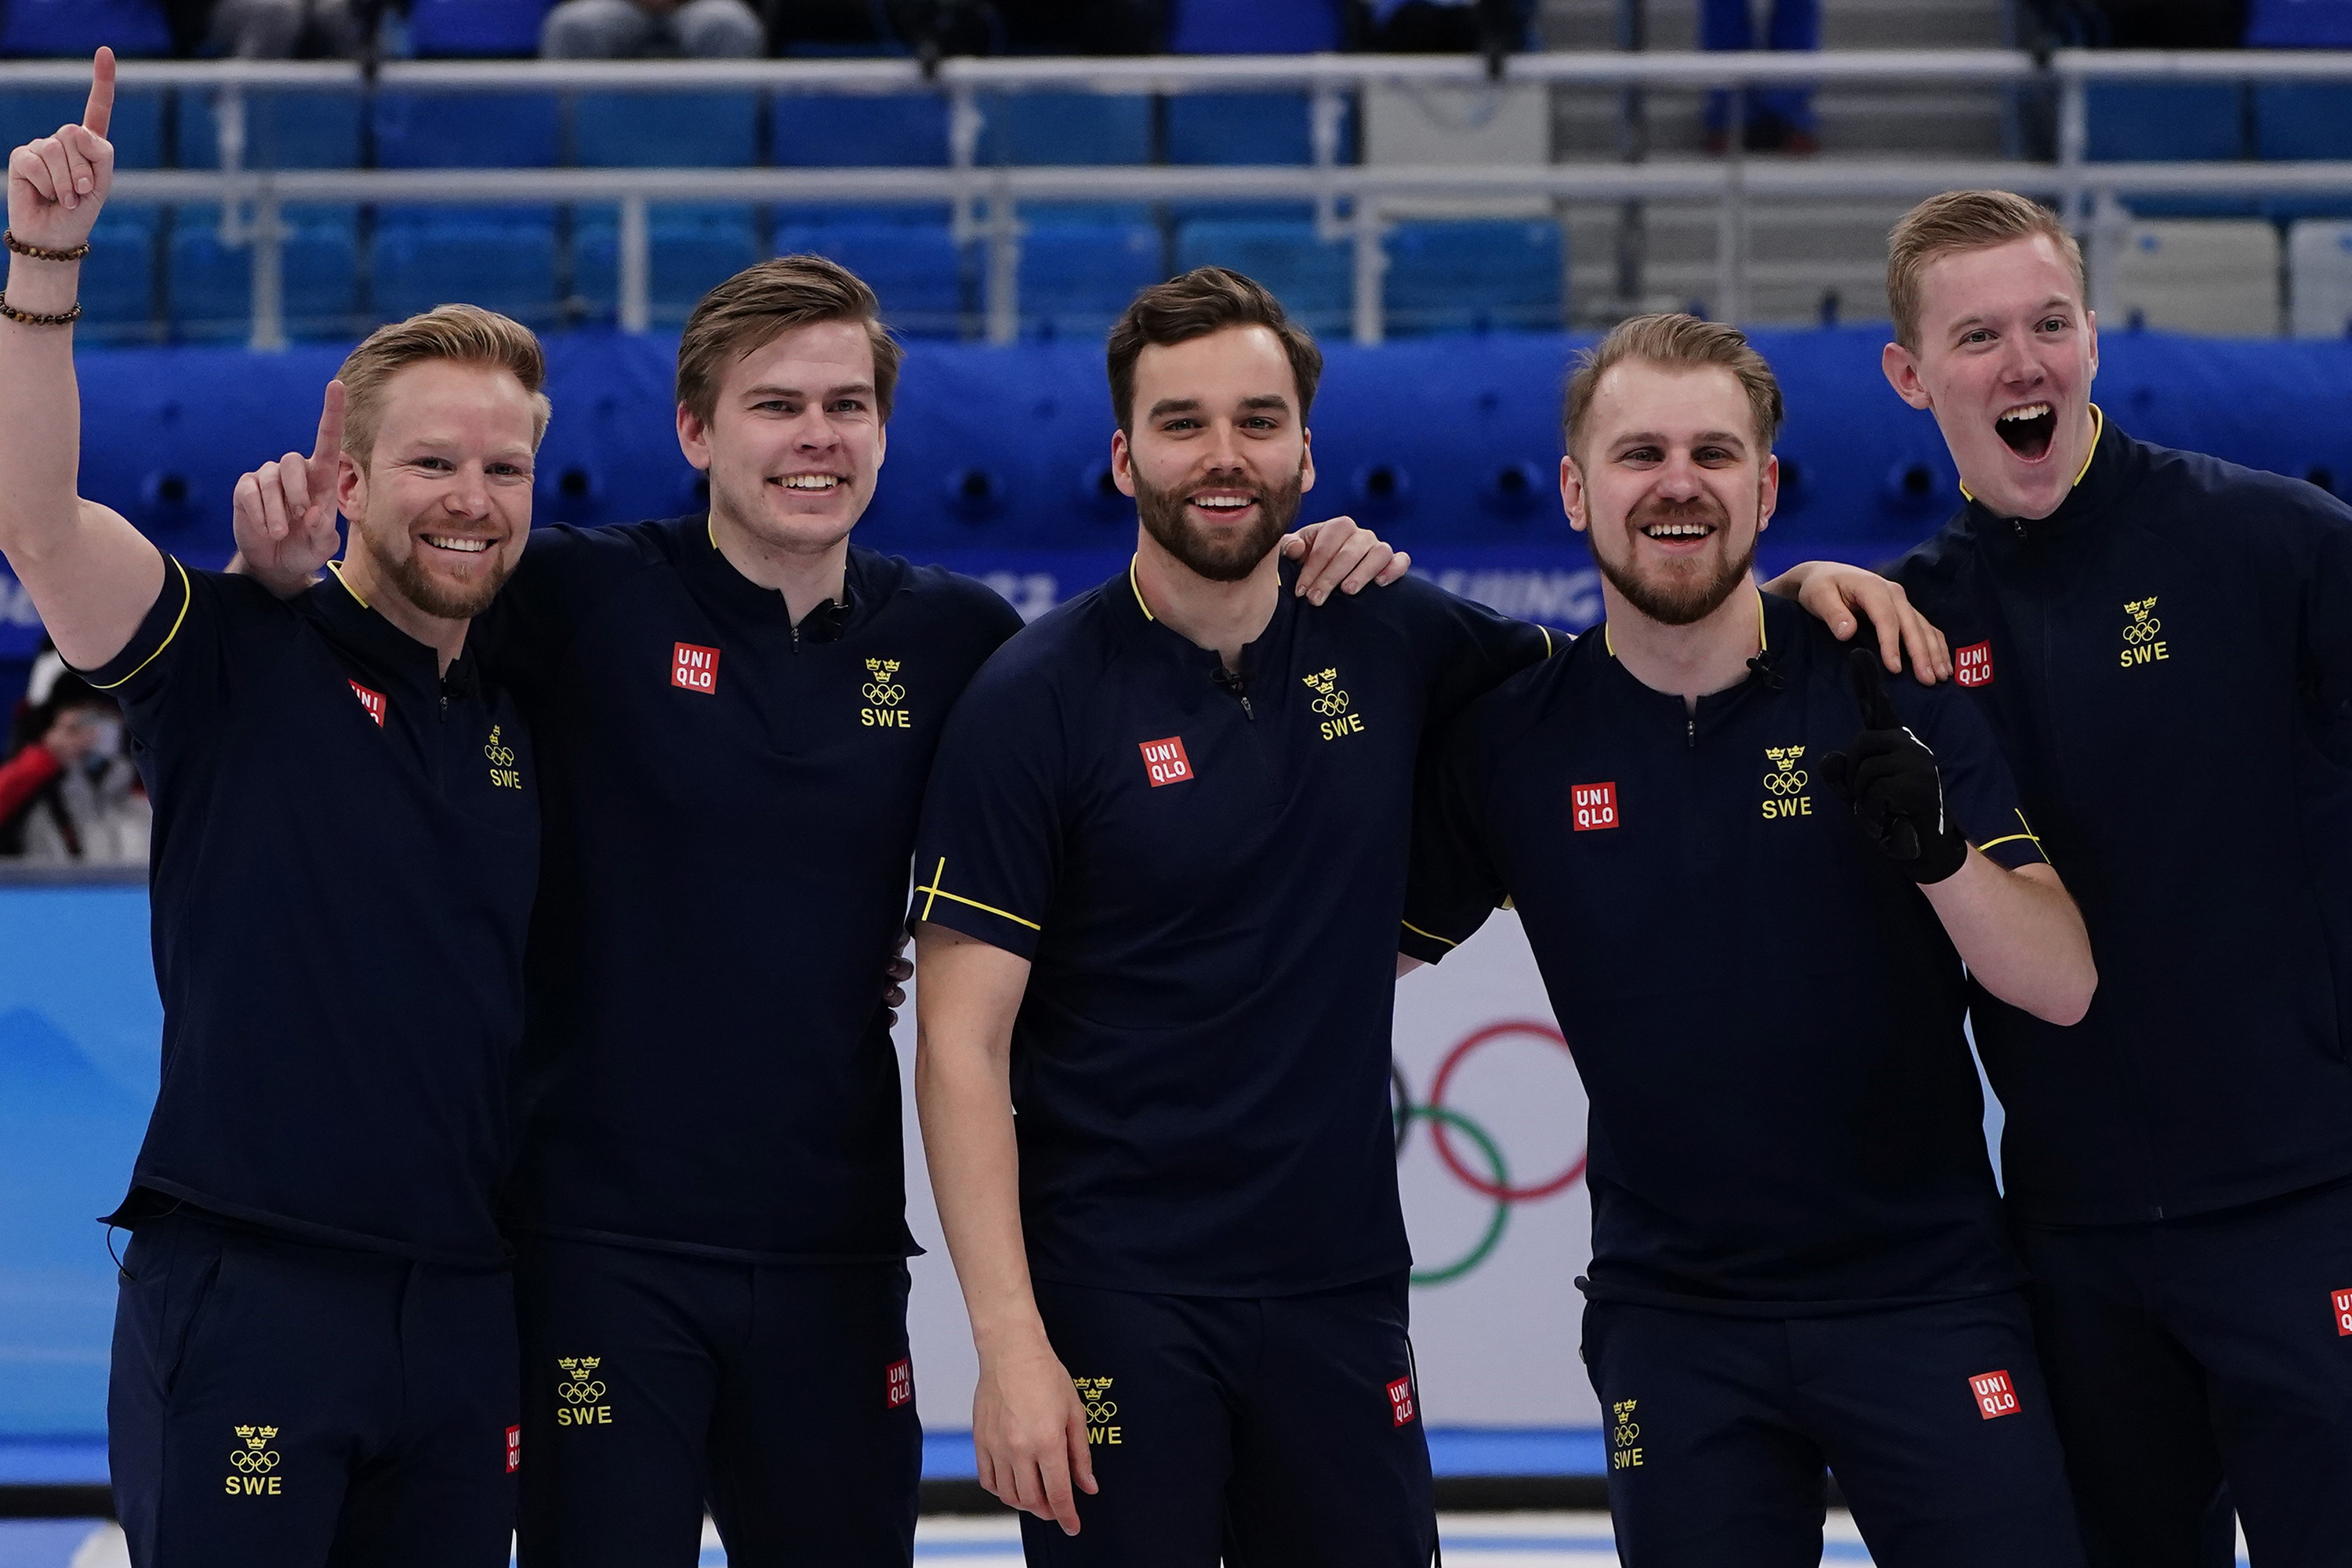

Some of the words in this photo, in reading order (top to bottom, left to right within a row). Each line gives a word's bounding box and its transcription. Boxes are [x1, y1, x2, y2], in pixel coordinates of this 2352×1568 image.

[678, 648, 712, 670] UNI
[1960, 647, 1988, 666] UNI
[2120, 641, 2169, 668] SWE
[676, 666, 713, 688] QLO
[1959, 664, 1991, 684] QLO
[861, 707, 911, 728] SWE
[1321, 713, 1365, 741] SWE
[1145, 742, 1178, 763] UNI
[489, 768, 522, 789] SWE
[1151, 760, 1186, 783] QLO
[1576, 788, 1610, 807] UNI
[1762, 794, 1813, 820] SWE
[1577, 807, 1613, 828] QLO
[890, 1363, 909, 1384] UNI
[891, 1381, 910, 1404] QLO
[1390, 1381, 1409, 1403] UNI
[1975, 1376, 2008, 1396] UNI
[1396, 1399, 1413, 1423] QLO
[1982, 1393, 2016, 1415] QLO
[557, 1406, 613, 1426] SWE
[1086, 1426, 1123, 1445] WE
[1613, 1447, 1644, 1470] SWE
[224, 1475, 283, 1496] SWE
